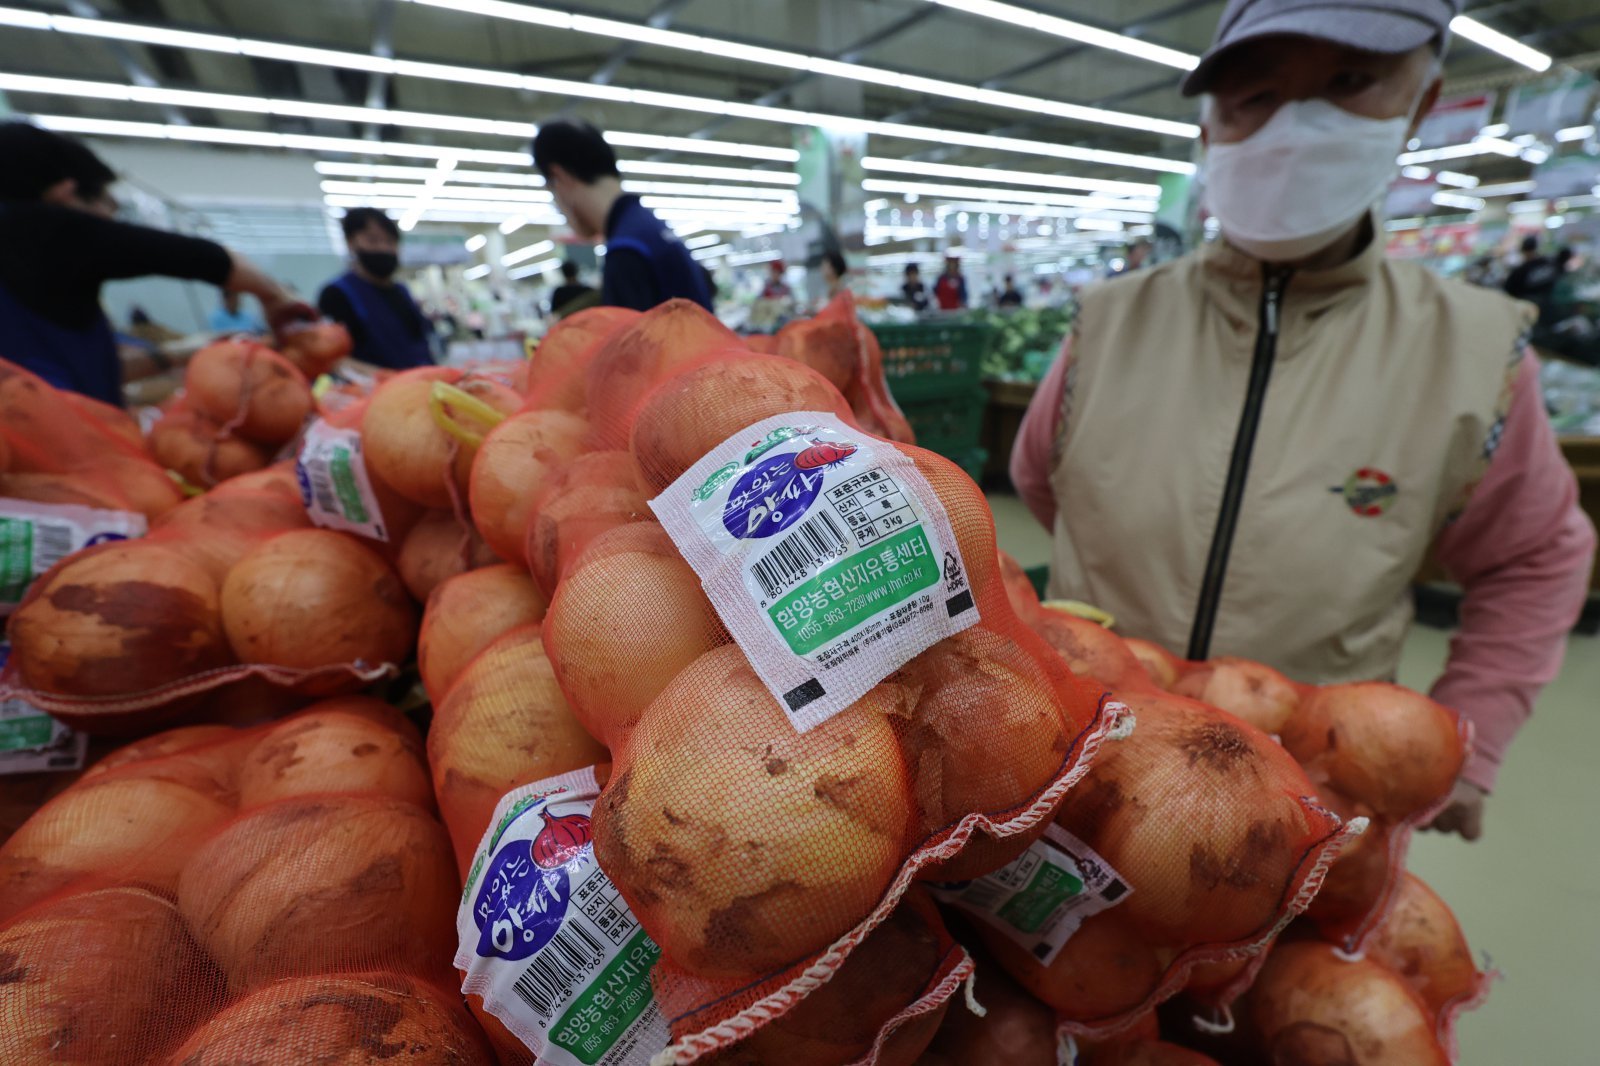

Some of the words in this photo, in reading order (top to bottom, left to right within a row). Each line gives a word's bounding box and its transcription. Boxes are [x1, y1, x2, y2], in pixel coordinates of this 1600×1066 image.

[833, 471, 881, 498] 표준규격품
[838, 498, 858, 513] 산지
[847, 511, 867, 526] 등급
[881, 499, 892, 509] 특
[857, 526, 875, 541] 무게
[775, 536, 927, 630] 함양농협산지유통센터
[947, 577, 964, 592] HDPE
[586, 896, 606, 916] 산지
[598, 908, 618, 929] 등급
[610, 919, 630, 939] 무게
